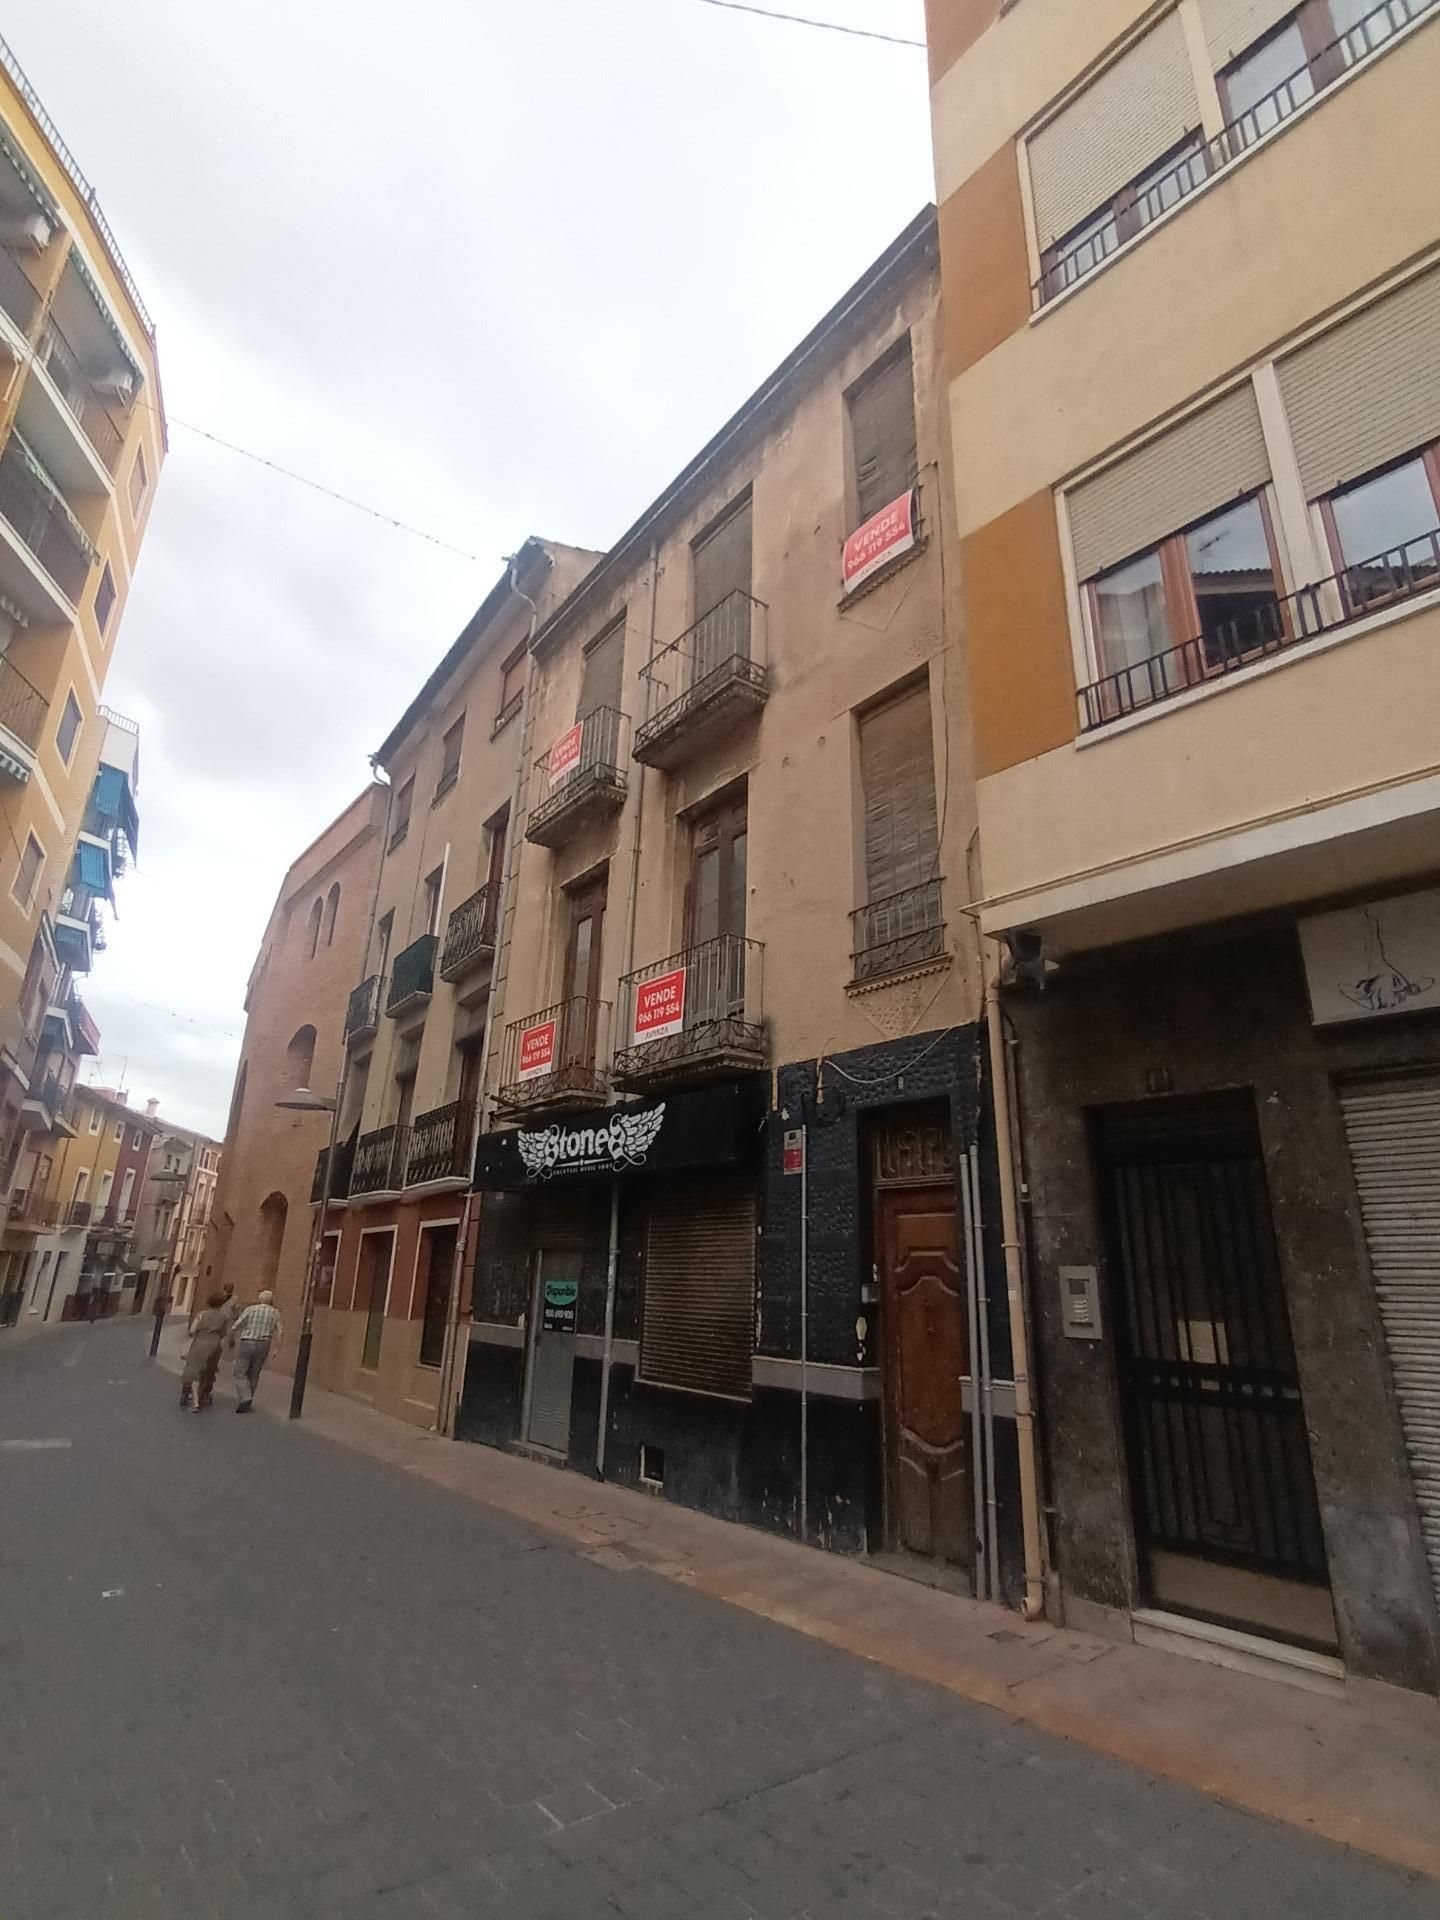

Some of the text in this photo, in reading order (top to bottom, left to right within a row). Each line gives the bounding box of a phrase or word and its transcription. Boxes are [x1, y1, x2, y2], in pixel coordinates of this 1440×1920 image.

[854, 511, 898, 551] VENDE
[644, 985, 677, 1008] VENDE
[638, 1011, 652, 1024] 966
[665, 1001, 680, 1016] 554
[527, 1033, 549, 1051] VENDE
